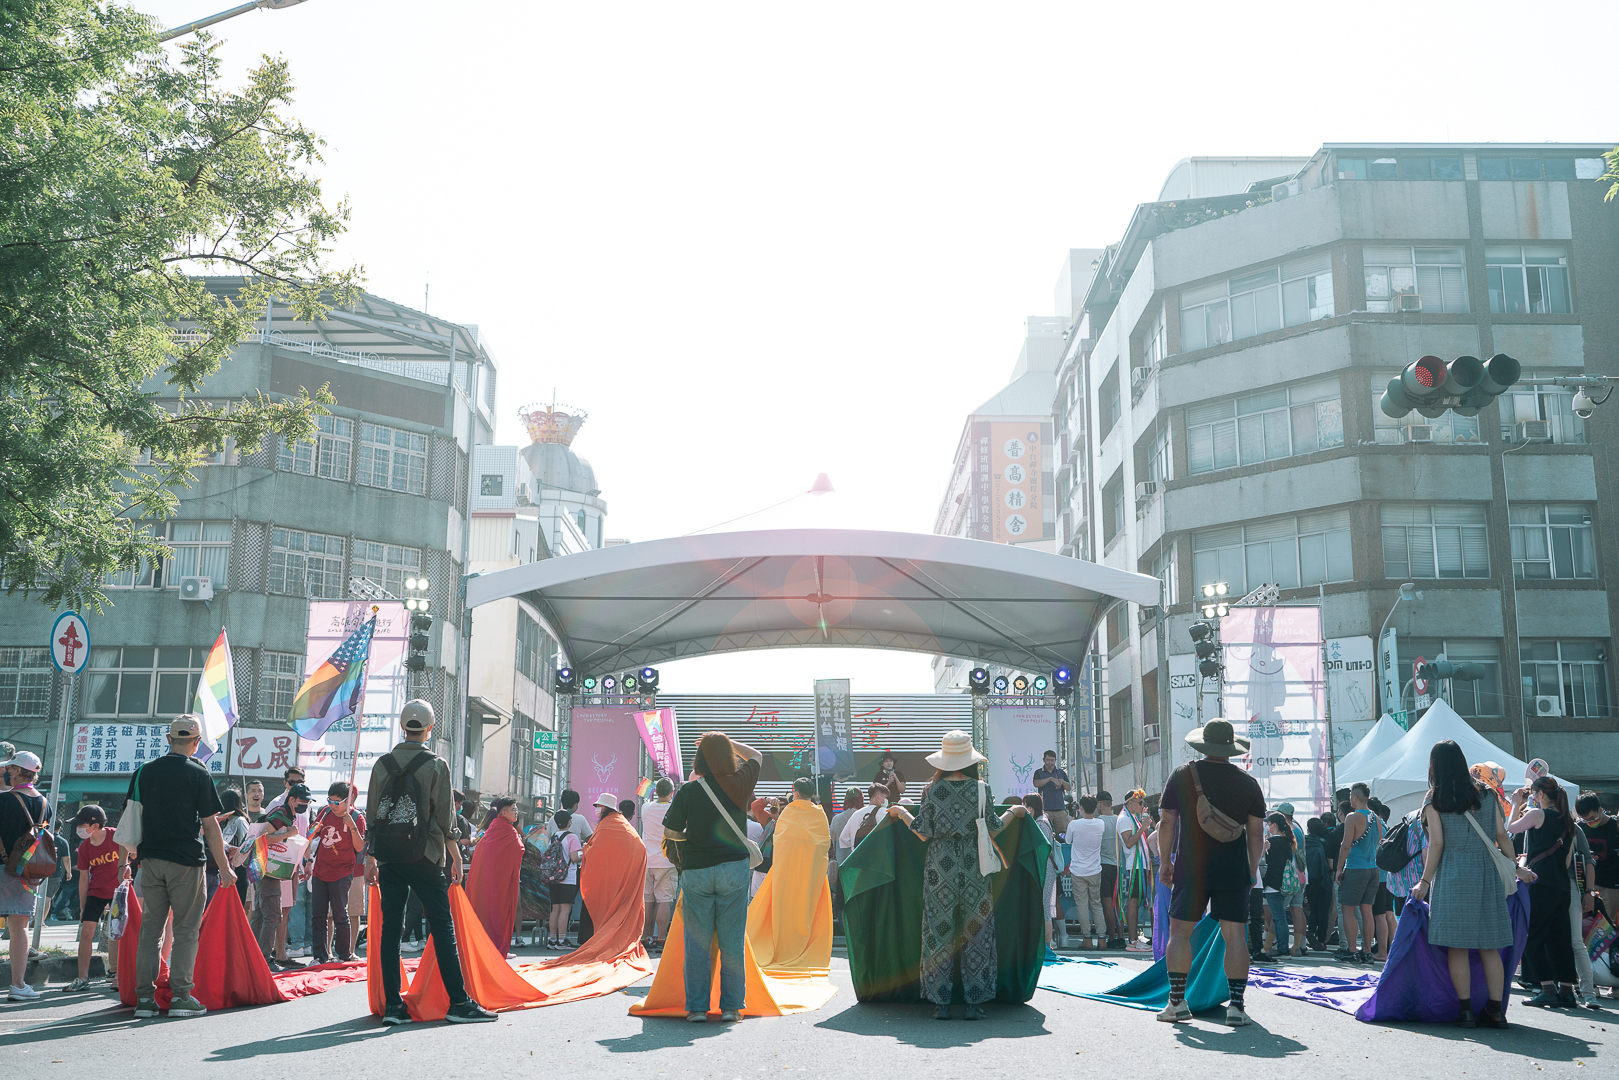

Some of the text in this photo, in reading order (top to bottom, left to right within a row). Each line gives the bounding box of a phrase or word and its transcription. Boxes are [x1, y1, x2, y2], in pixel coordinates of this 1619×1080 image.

[1007, 440, 1025, 533] 普高精舍
[1172, 674, 1195, 688] SMC
[820, 693, 833, 736] 大平台
[1248, 720, 1310, 738] 無色彩虹
[74, 726, 88, 771] 馬達部專營
[88, 726, 103, 772] 減速馬達
[104, 726, 118, 772] 各式邦浦
[150, 726, 162, 758] 直流馬
[330, 750, 374, 760] GILEAD
[1256, 757, 1300, 766] GILEAD
[90, 850, 120, 866] YMCA
